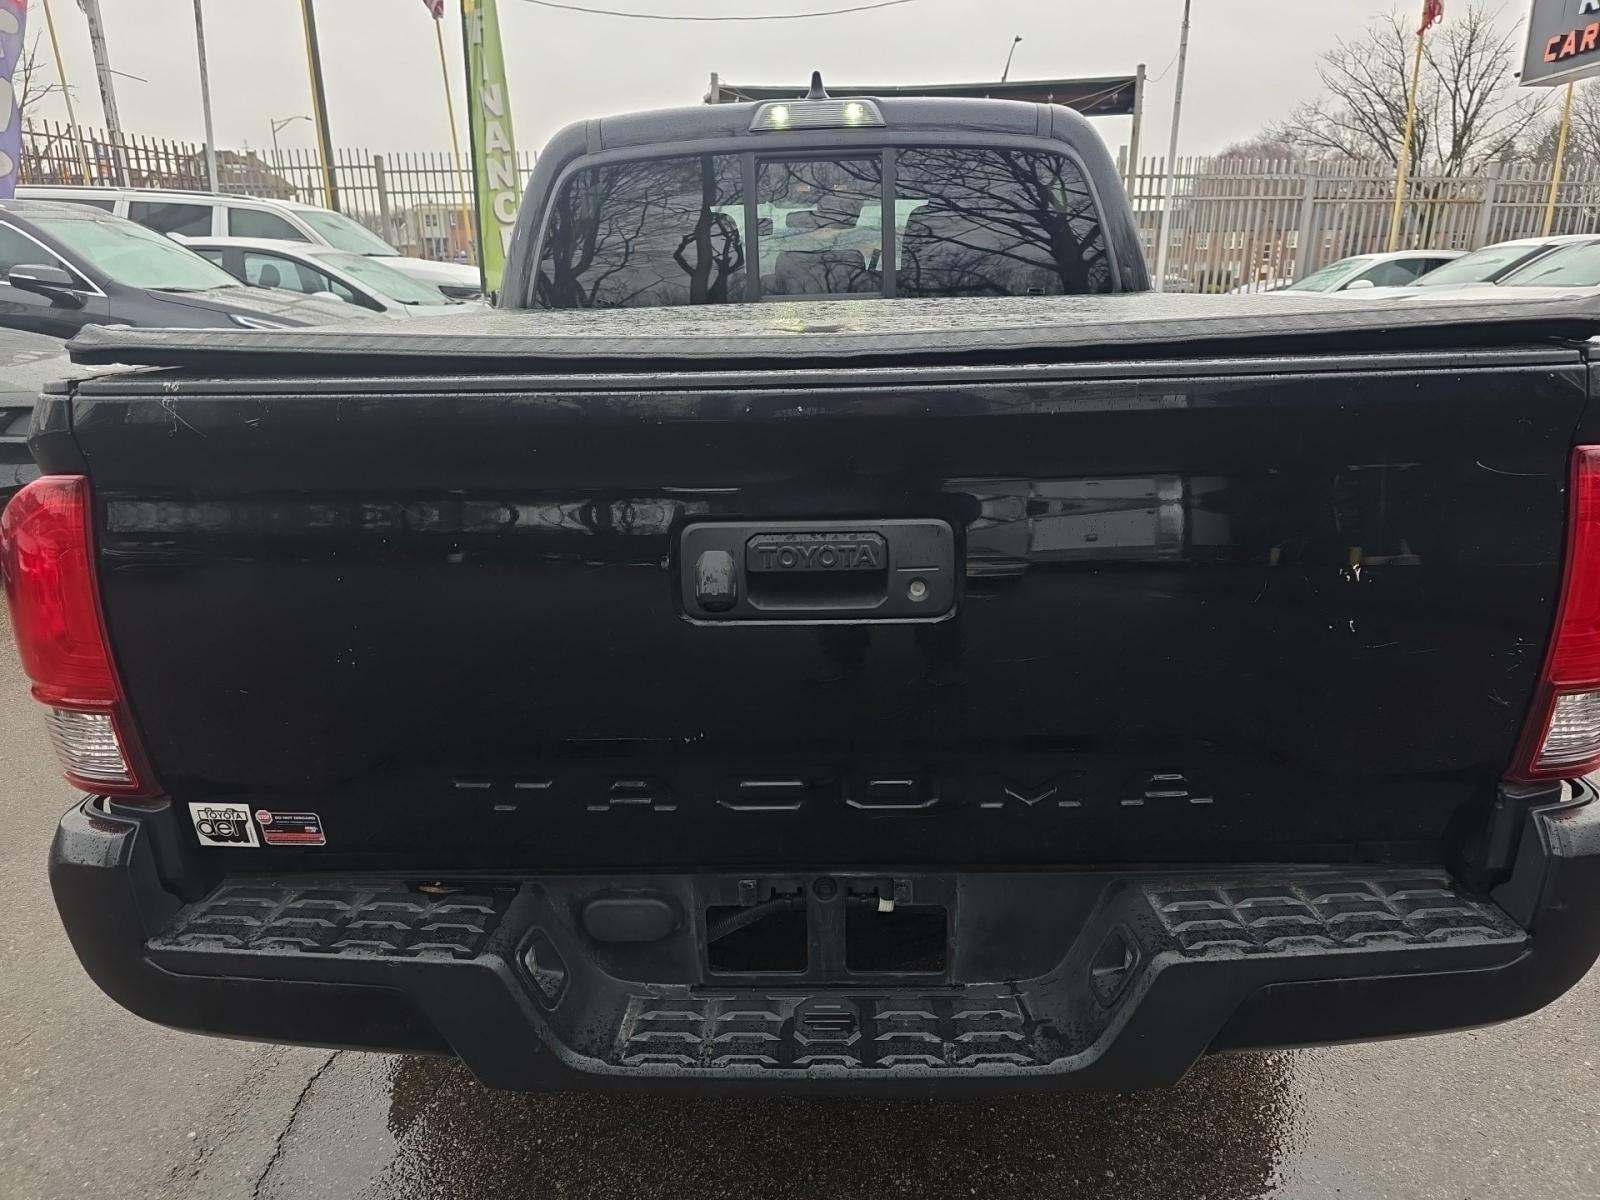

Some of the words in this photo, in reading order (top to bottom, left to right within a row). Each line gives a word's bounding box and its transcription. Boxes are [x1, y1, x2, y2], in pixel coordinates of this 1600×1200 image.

[1544, 21, 1600, 63] CAR
[757, 544, 878, 569] TOYOTA
[450, 772, 1214, 813] TACOMA
[203, 808, 243, 819] TOYOTA
